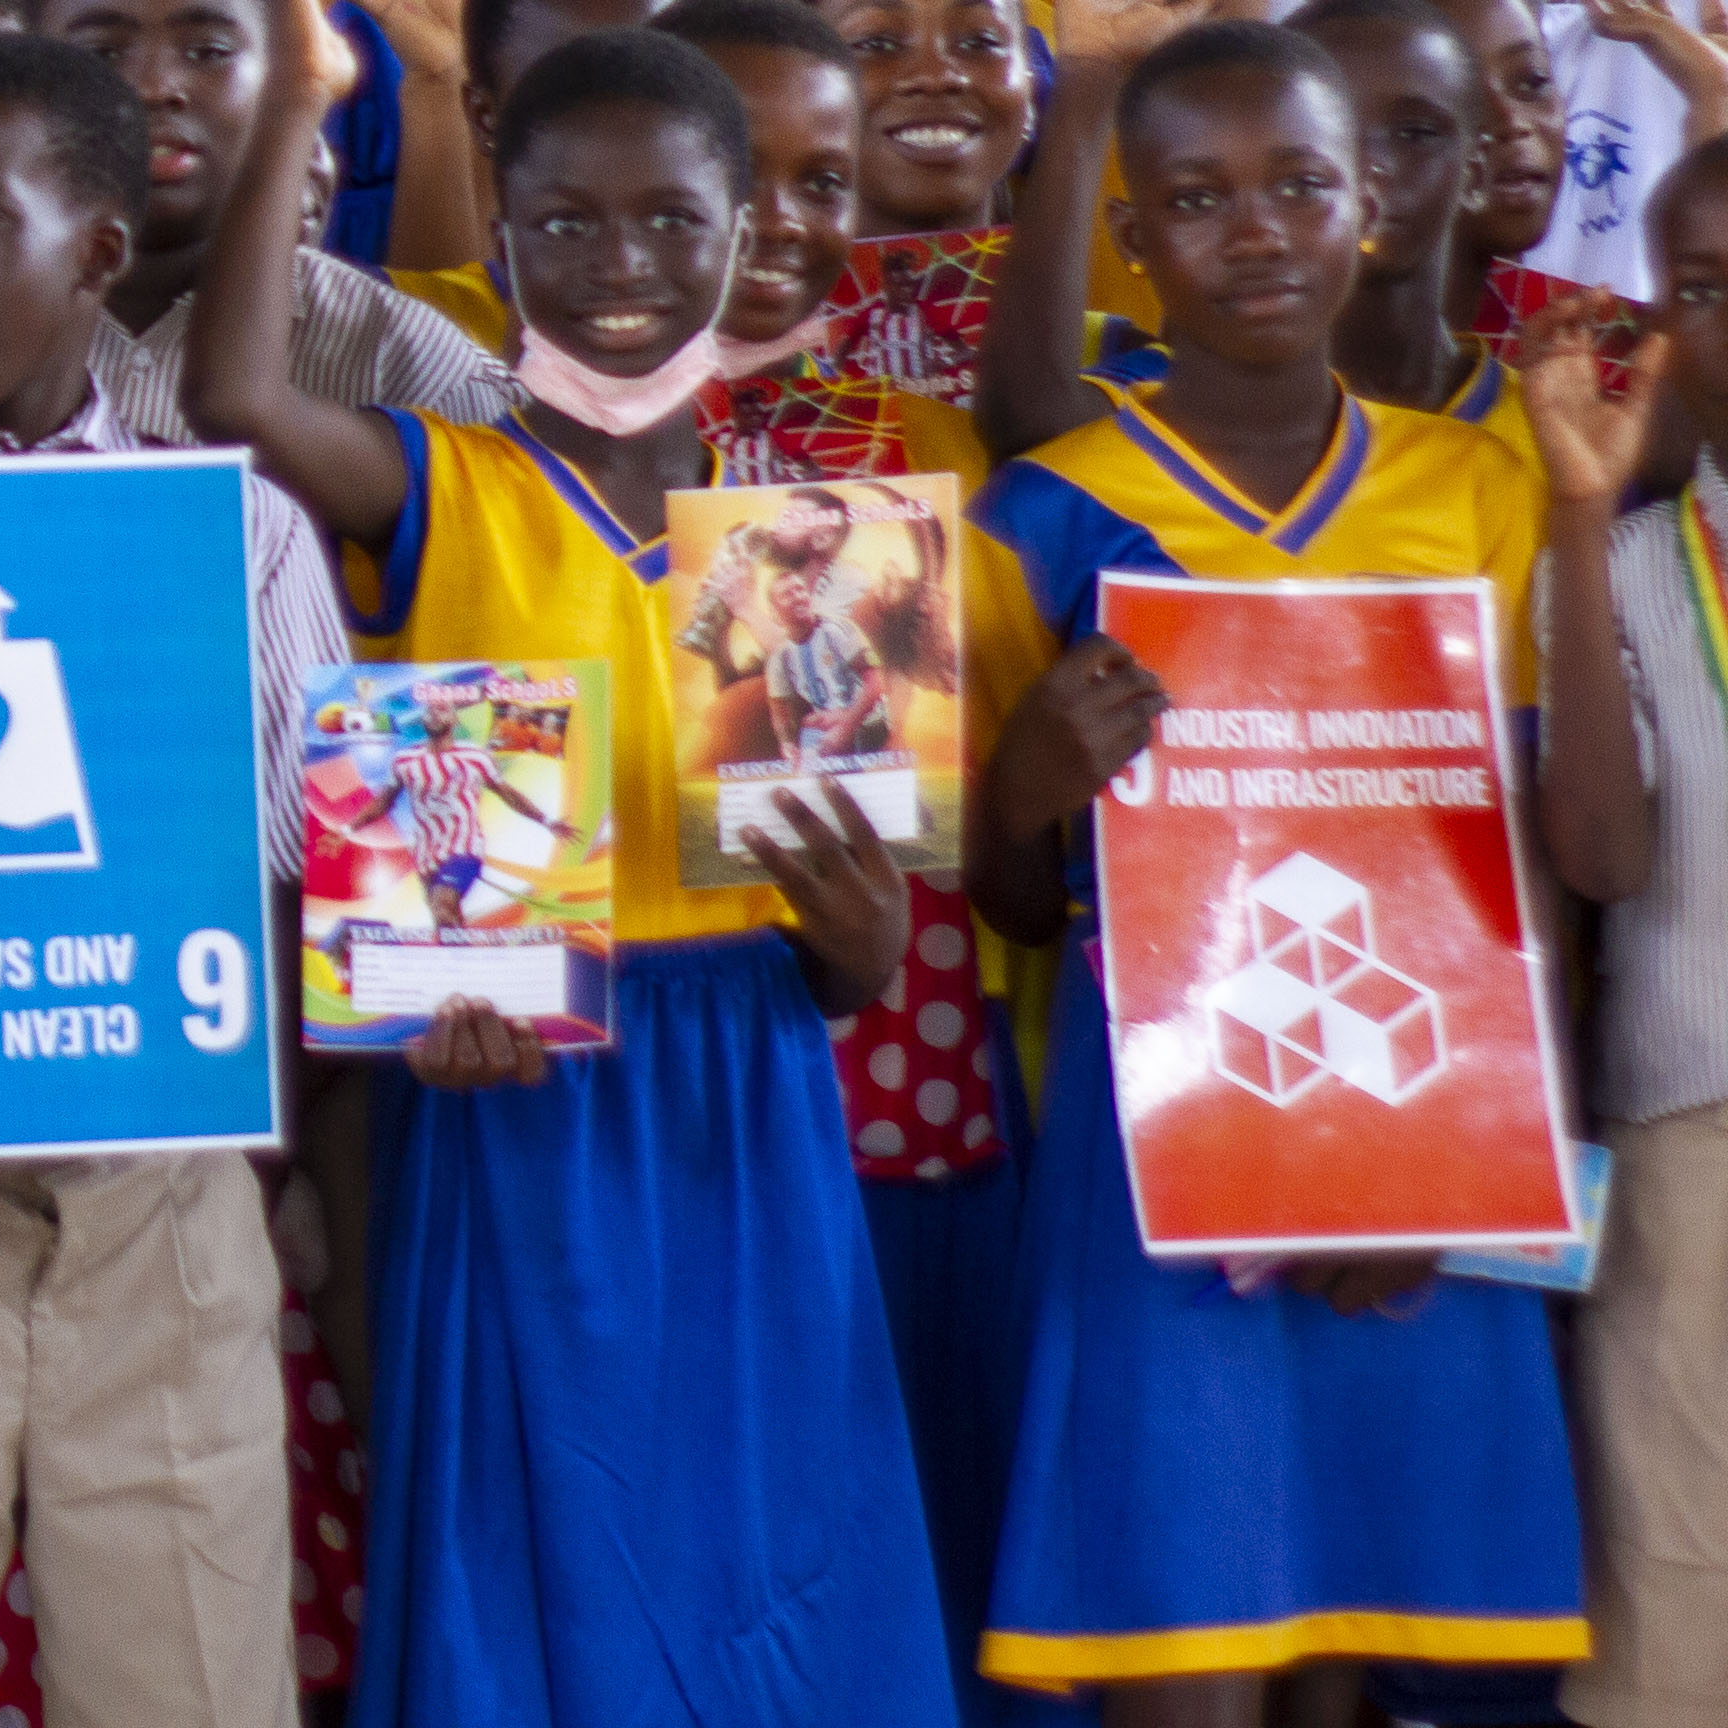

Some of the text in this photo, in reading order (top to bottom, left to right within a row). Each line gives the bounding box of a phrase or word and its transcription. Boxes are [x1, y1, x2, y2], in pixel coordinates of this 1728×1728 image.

[1306, 709, 1486, 749] INNOVATION
[1166, 766, 1230, 807] AND
[1230, 766, 1495, 809] INFRASTRUCTURE
[44, 932, 137, 987] AND
[177, 927, 250, 1052] 6
[1, 1003, 141, 1060] CLEAN
